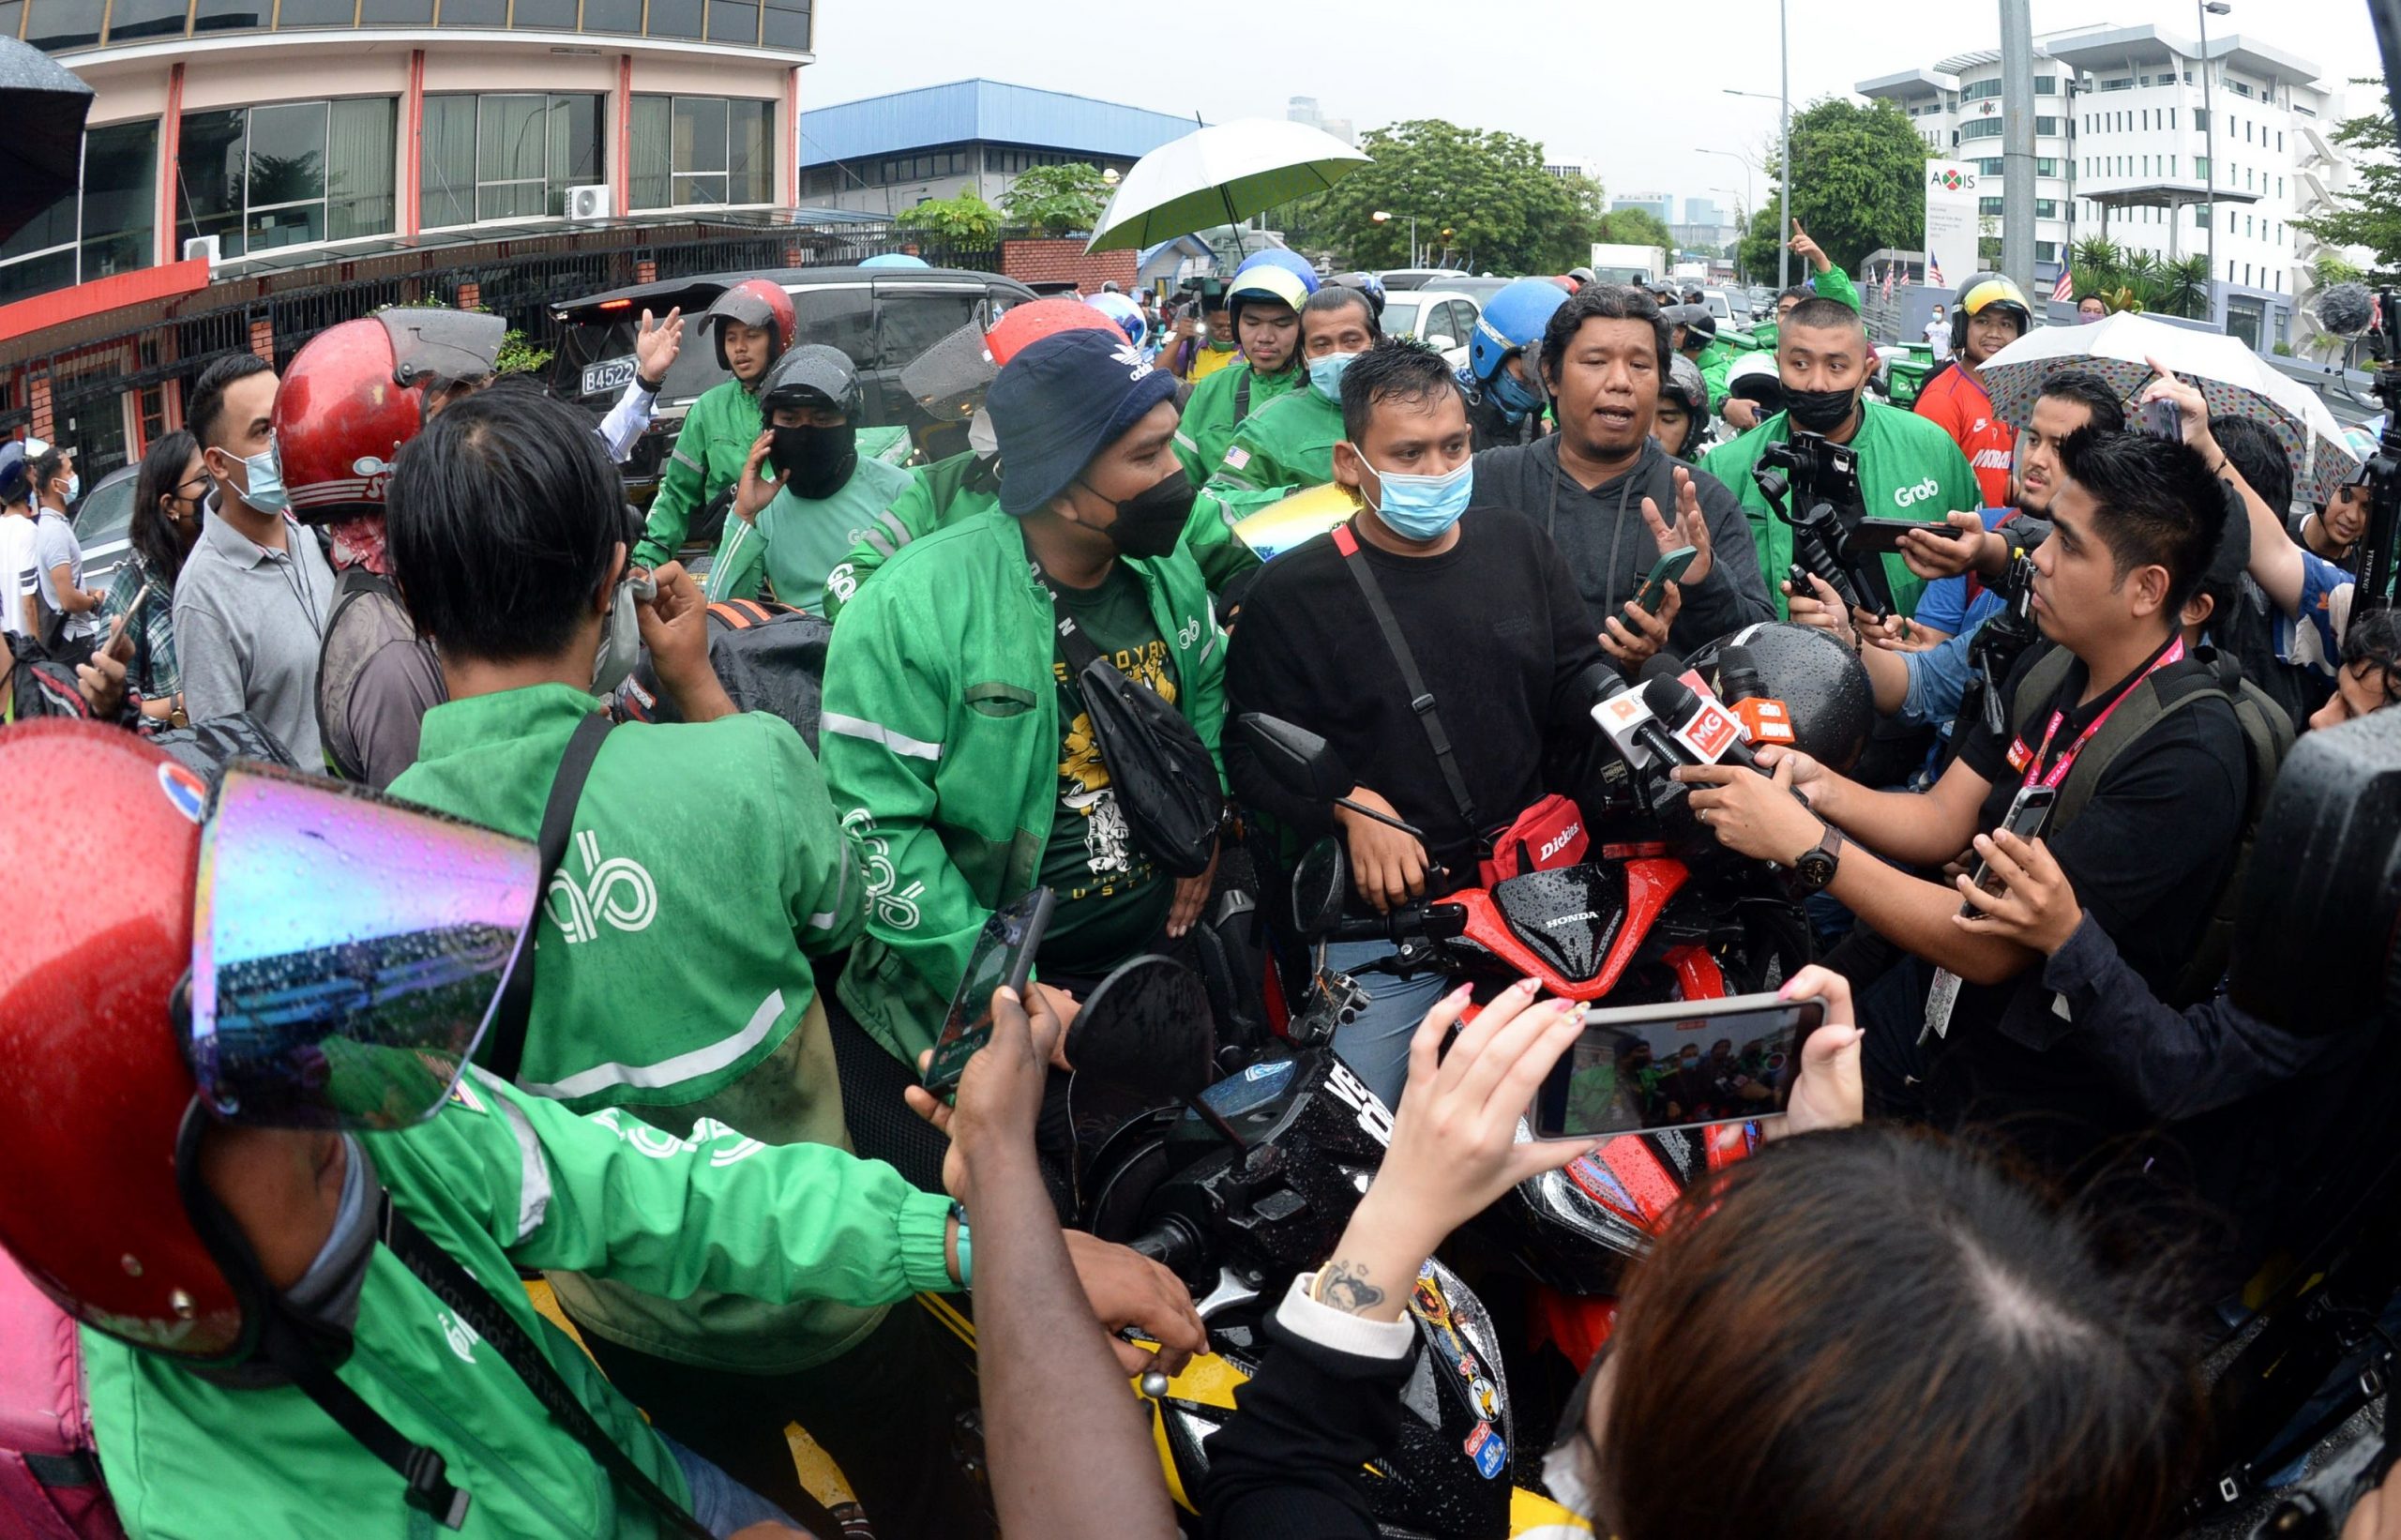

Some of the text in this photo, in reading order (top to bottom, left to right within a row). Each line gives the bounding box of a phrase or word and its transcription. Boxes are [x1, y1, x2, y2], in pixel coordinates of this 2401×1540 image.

[586, 362, 635, 391] B4522
[1895, 476, 1939, 507] Grab
[1691, 712, 1723, 747] MG
[1540, 822, 1579, 862] Dickies
[1546, 911, 1598, 929] HONDA
